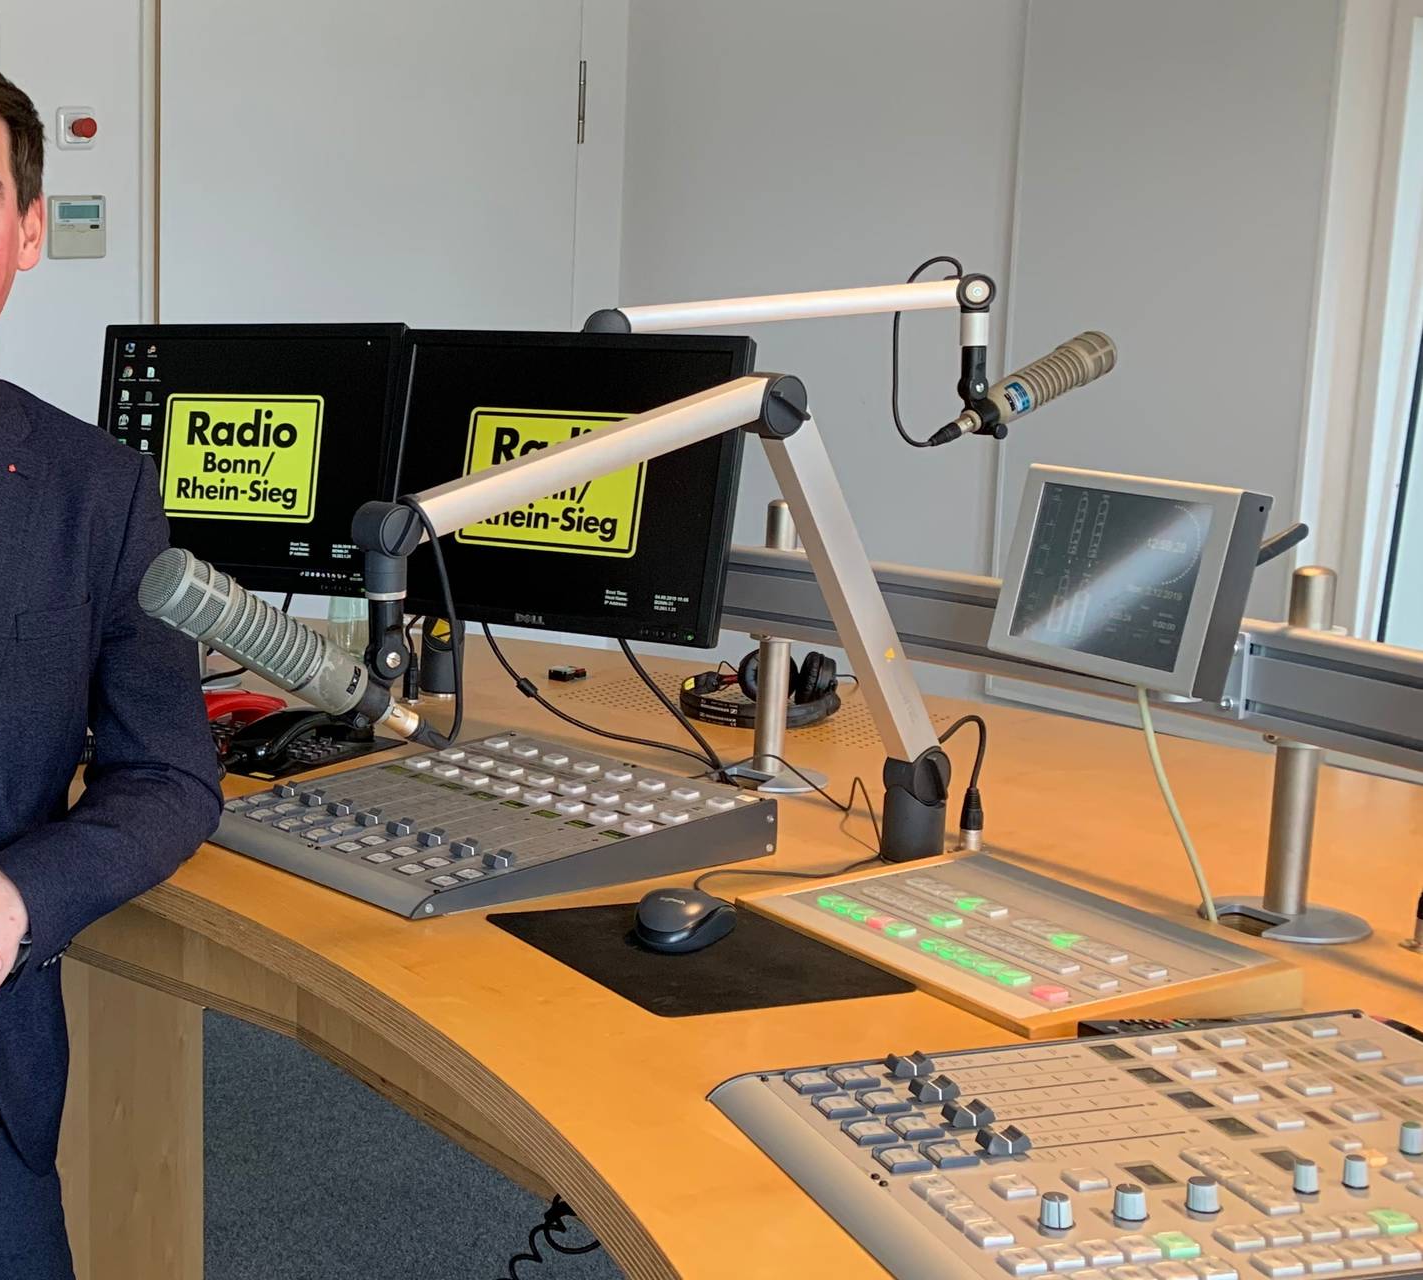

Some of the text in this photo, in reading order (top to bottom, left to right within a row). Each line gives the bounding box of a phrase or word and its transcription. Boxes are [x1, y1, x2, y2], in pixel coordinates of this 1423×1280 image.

[186, 408, 298, 448] Radio
[202, 451, 275, 477] Bonn/
[176, 476, 297, 510] Rhein-Sieg
